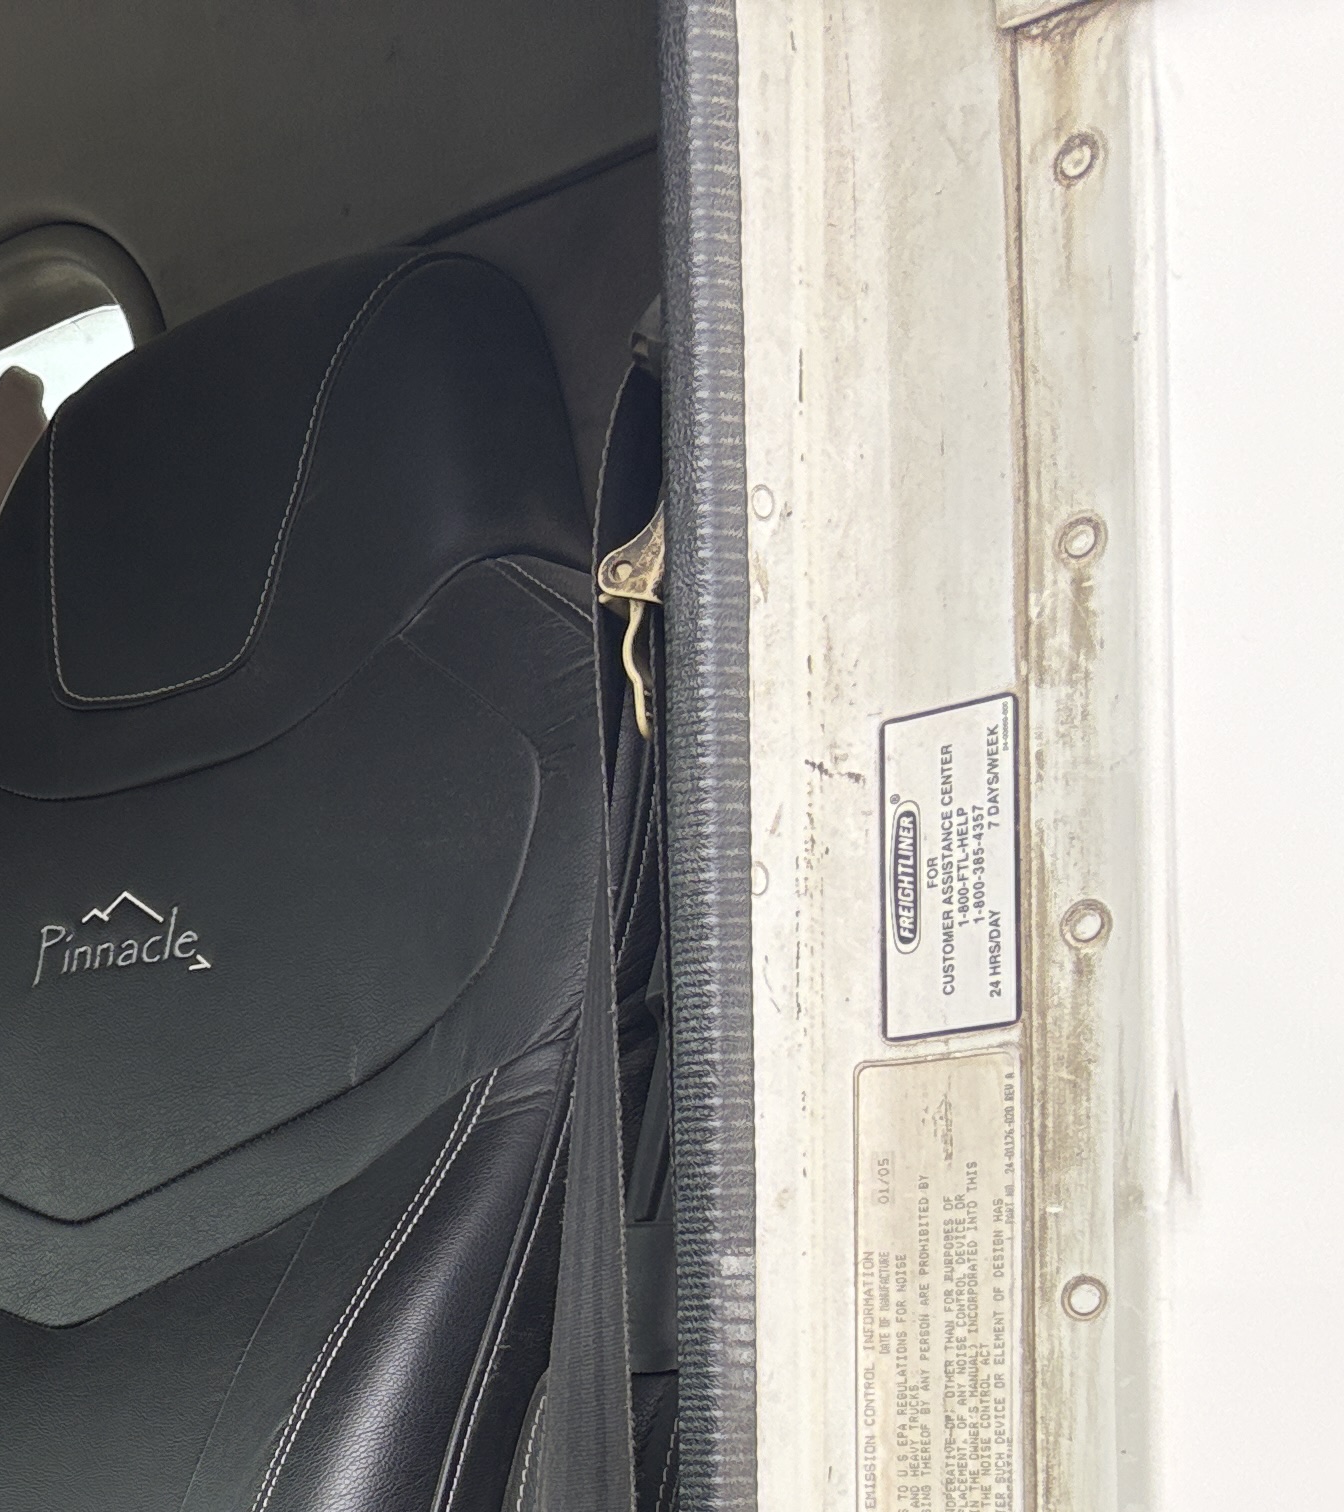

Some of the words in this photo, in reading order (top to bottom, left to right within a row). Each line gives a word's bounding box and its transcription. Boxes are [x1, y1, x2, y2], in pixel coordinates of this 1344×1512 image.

[941, 744, 953, 806] CENTER
[987, 724, 999, 816] DAYS/WEEK
[988, 821, 1000, 830] 7
[927, 857, 938, 889] FOR
[941, 810, 953, 905] ASSISTANCE
[957, 807, 969, 926] 1-800-FTL-HELP
[972, 805, 984, 923] 1-800-385-4357
[897, 816, 914, 938] FREIGHTLINER
[31, 906, 199, 988] Pinnacle
[942, 910, 954, 995] CUSTOMER
[989, 910, 1001, 976] HRS/DAY
[989, 980, 1001, 997] 24
[878, 1158, 889, 1204] 01/05
[918, 1175, 929, 1189] BY
[966, 1161, 977, 1192] THIS
[943, 1196, 953, 1211] OF
[955, 1194, 965, 1209] OR
[966, 1201, 977, 1231] INTO
[993, 1198, 1003, 1222] HAS
[918, 1197, 929, 1275] PROHIBITED
[943, 1219, 954, 1282] PURPOSES
[955, 1218, 966, 1264] DEVICE
[993, 1230, 1004, 1278] DESIGN
[878, 1252, 890, 1311] MANUFACTURE
[895, 1254, 907, 1292] NOISE
[967, 1240, 978, 1334] INCORPORATED
[863, 1251, 875, 1351] INFORMATION
[896, 1300, 907, 1323] FOR
[919, 1283, 929, 1305] ARE
[944, 1289, 954, 1312] FOR
[955, 1273, 966, 1327] CONTROL
[993, 1286, 1004, 1301] OF
[879, 1317, 890, 1327] OF
[919, 1314, 930, 1360] PERSON
[944, 1320, 954, 1350] THAN
[993, 1310, 1005, 1365] ELEMENT
[879, 1333, 890, 1354] DATE
[956, 1335, 967, 1374] NOISE
[980, 1343, 990, 1366] ACT
[896, 1331, 907, 1415] REGULATIONS
[920, 1369, 930, 1391] ANY
[944, 1360, 955, 1398] OTHER
[967, 1344, 979, 1397] MANUAL)
[994, 1373, 1005, 1388] OR
[863, 1362, 875, 1427] CONTROL
[920, 1400, 931, 1414] BY
[956, 1383, 967, 1406] ANY
[980, 1374, 991, 1429] CONTROL
[897, 1424, 908, 1446] EPA
[957, 1414, 967, 1429] OF
[994, 1397, 1006, 1444] DEVICE
[910, 1439, 920, 1477] HEAVY
[920, 1424, 931, 1476] THEREOF
[980, 1437, 991, 1475] NOISE
[995, 1452, 1006, 1484] SUCH
[865, 1435, 876, 1509] EMISSION
[969, 1469, 980, 1491] THE
[897, 1485, 909, 1500] TO
[910, 1485, 921, 1508] AND
[981, 1485, 991, 1507] THE
